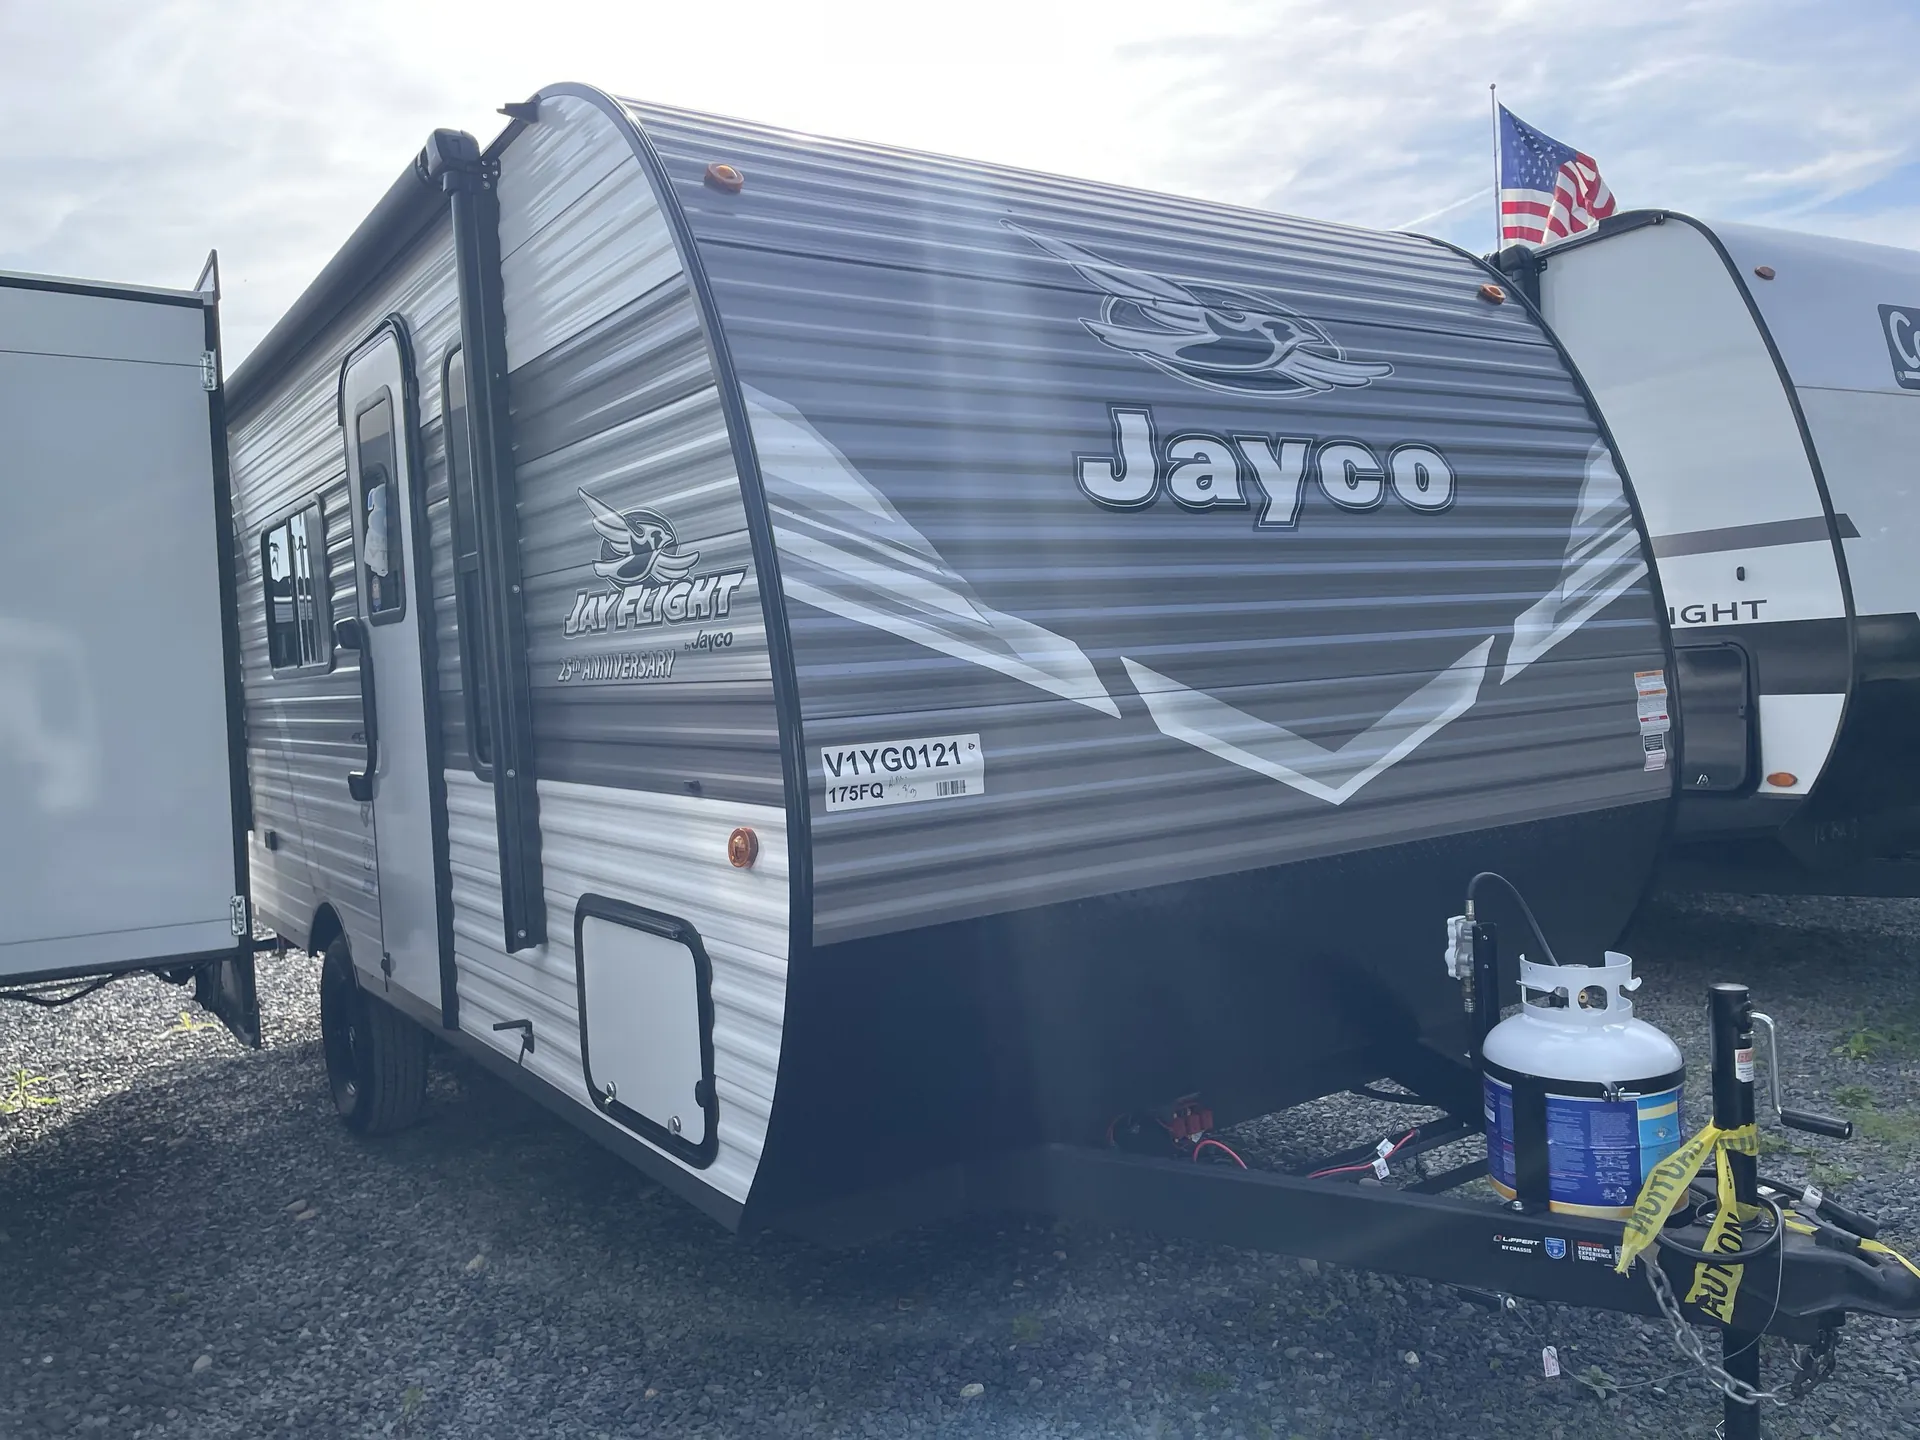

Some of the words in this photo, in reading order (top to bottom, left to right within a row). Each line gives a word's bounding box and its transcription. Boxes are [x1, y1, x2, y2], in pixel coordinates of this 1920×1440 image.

[1889, 310, 1920, 369] C
[1073, 403, 1456, 530] Jayco
[564, 589, 620, 638] JAY
[614, 566, 748, 629] FLIGHT
[691, 630, 733, 652] Jayco
[557, 656, 581, 683] 25th
[581, 649, 676, 681] ANNIVERSARY
[823, 741, 962, 778] V1YG0121
[828, 782, 884, 804] 175FQ
